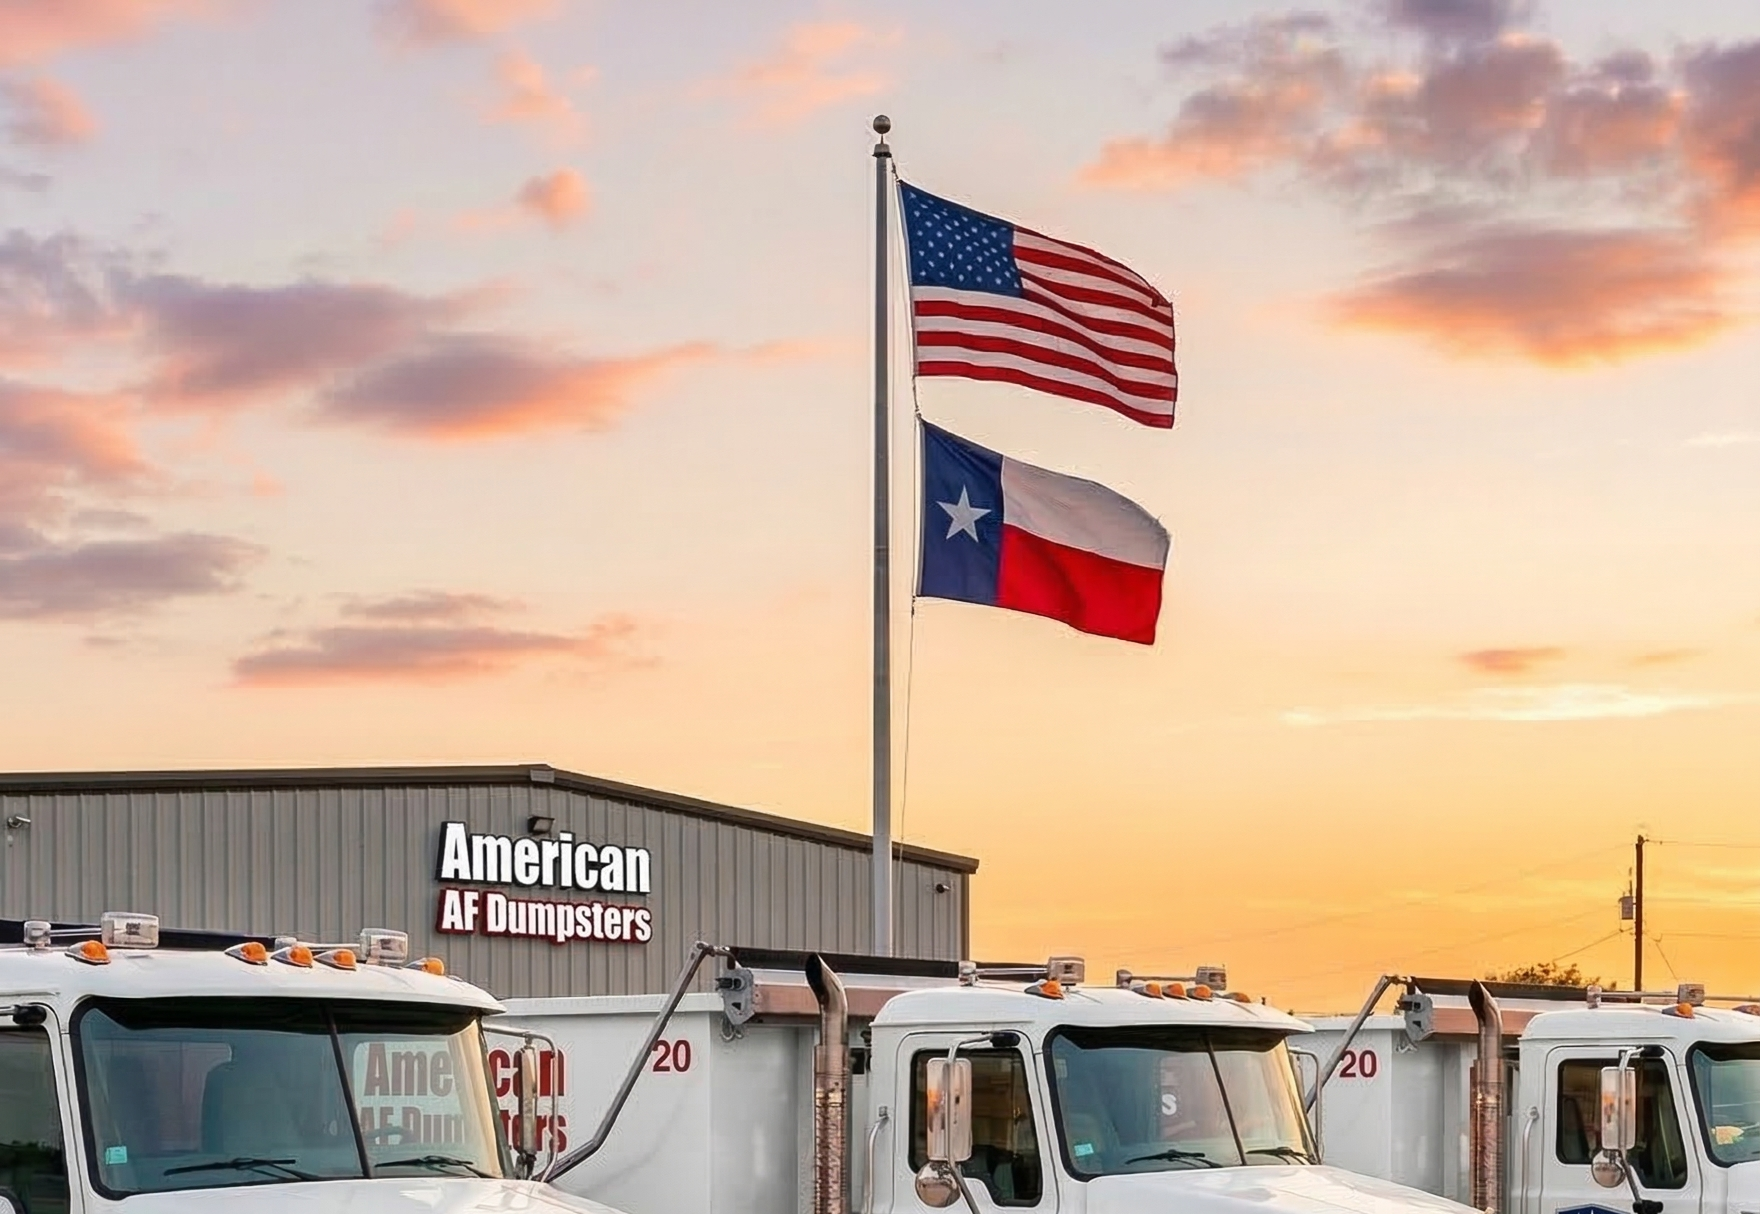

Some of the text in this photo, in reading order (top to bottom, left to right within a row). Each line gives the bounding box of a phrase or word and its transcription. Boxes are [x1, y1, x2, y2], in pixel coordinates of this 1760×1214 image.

[439, 821, 650, 893] American
[440, 889, 651, 943] AF Dumpsters
[364, 1042, 565, 1097] Amecn
[652, 1039, 691, 1072] 20
[1339, 1050, 1378, 1078] 20
